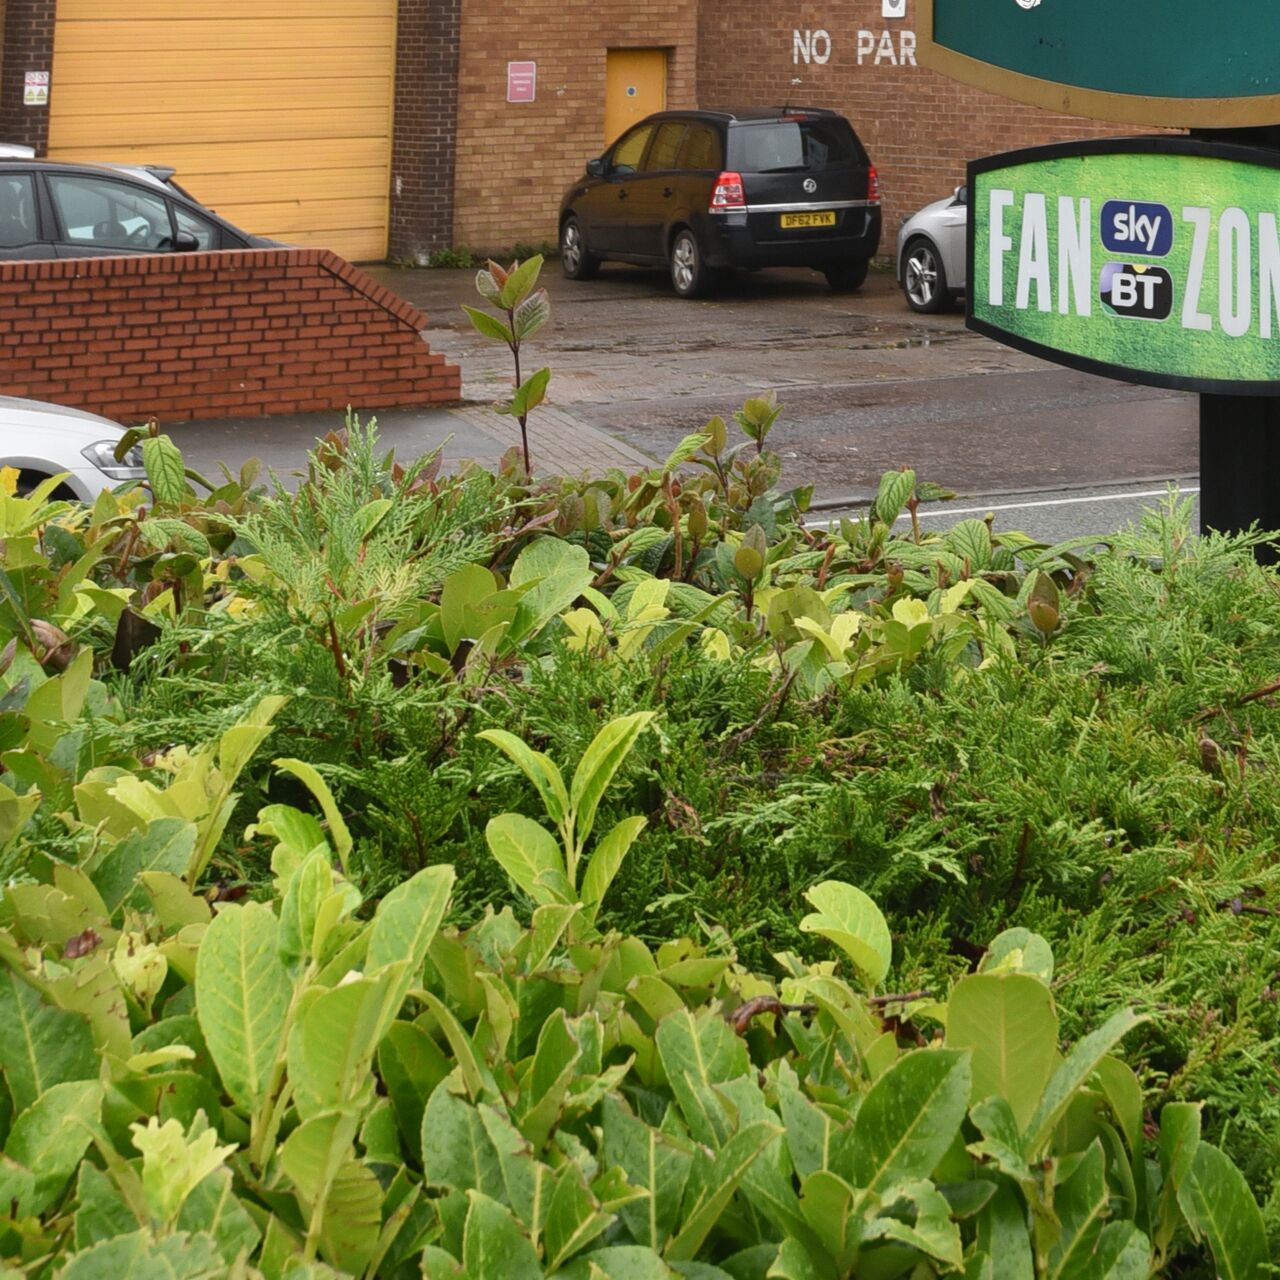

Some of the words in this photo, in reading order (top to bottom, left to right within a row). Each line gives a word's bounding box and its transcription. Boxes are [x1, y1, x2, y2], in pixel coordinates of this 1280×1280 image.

[793, 29, 832, 65] NO
[1113, 205, 1161, 252] sky
[988, 189, 1091, 317] FAN
[1111, 273, 1162, 310] BT
